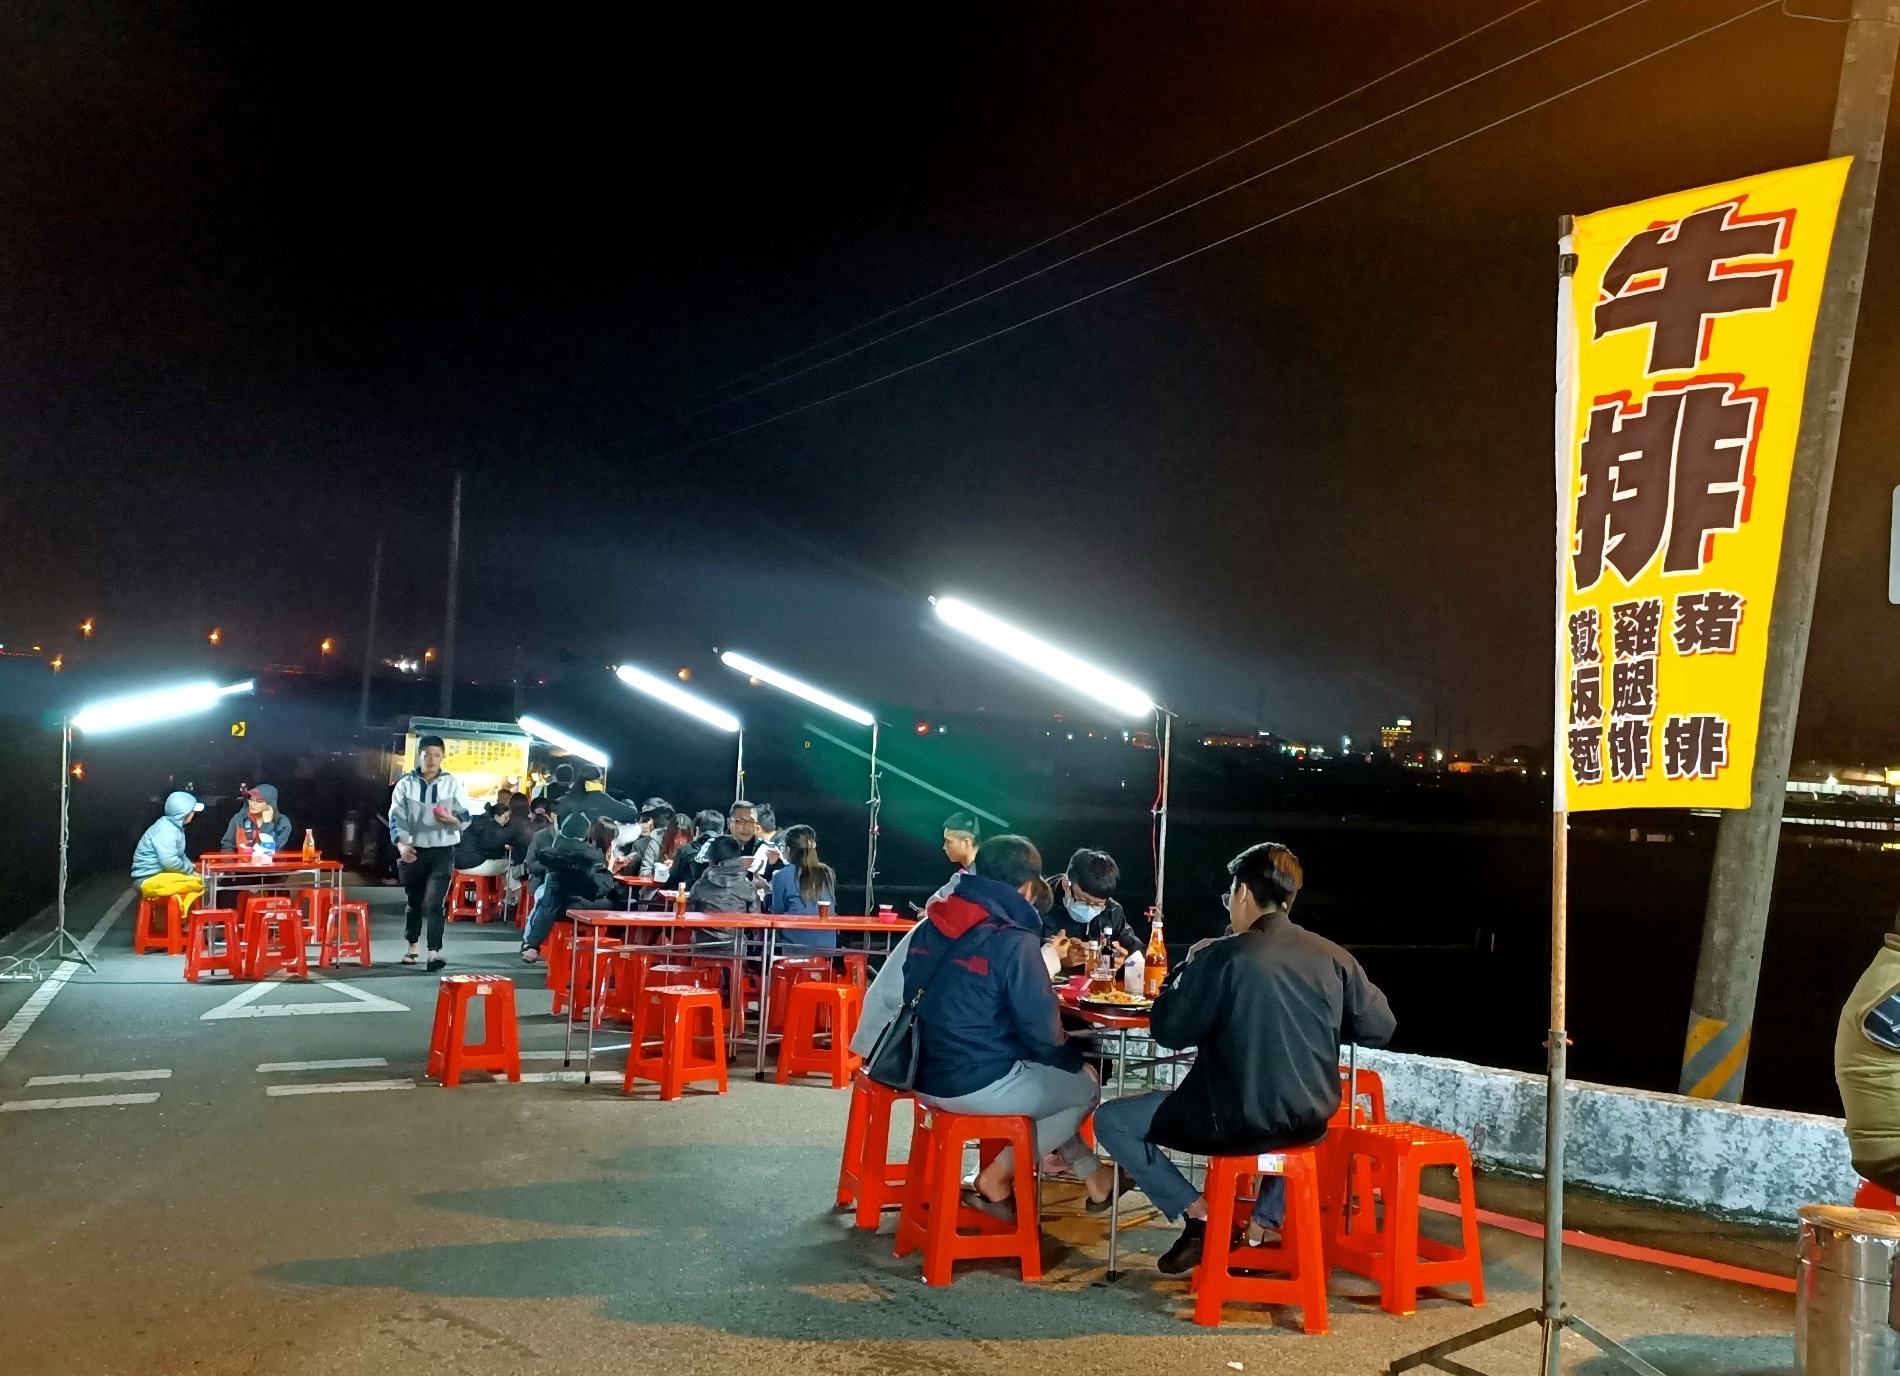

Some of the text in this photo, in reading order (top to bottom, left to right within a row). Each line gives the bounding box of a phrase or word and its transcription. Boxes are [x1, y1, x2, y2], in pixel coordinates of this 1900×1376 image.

[1573, 196, 1794, 590] 牛排
[1609, 600, 1664, 780] 雞腿排
[1665, 592, 1746, 779] 豬排
